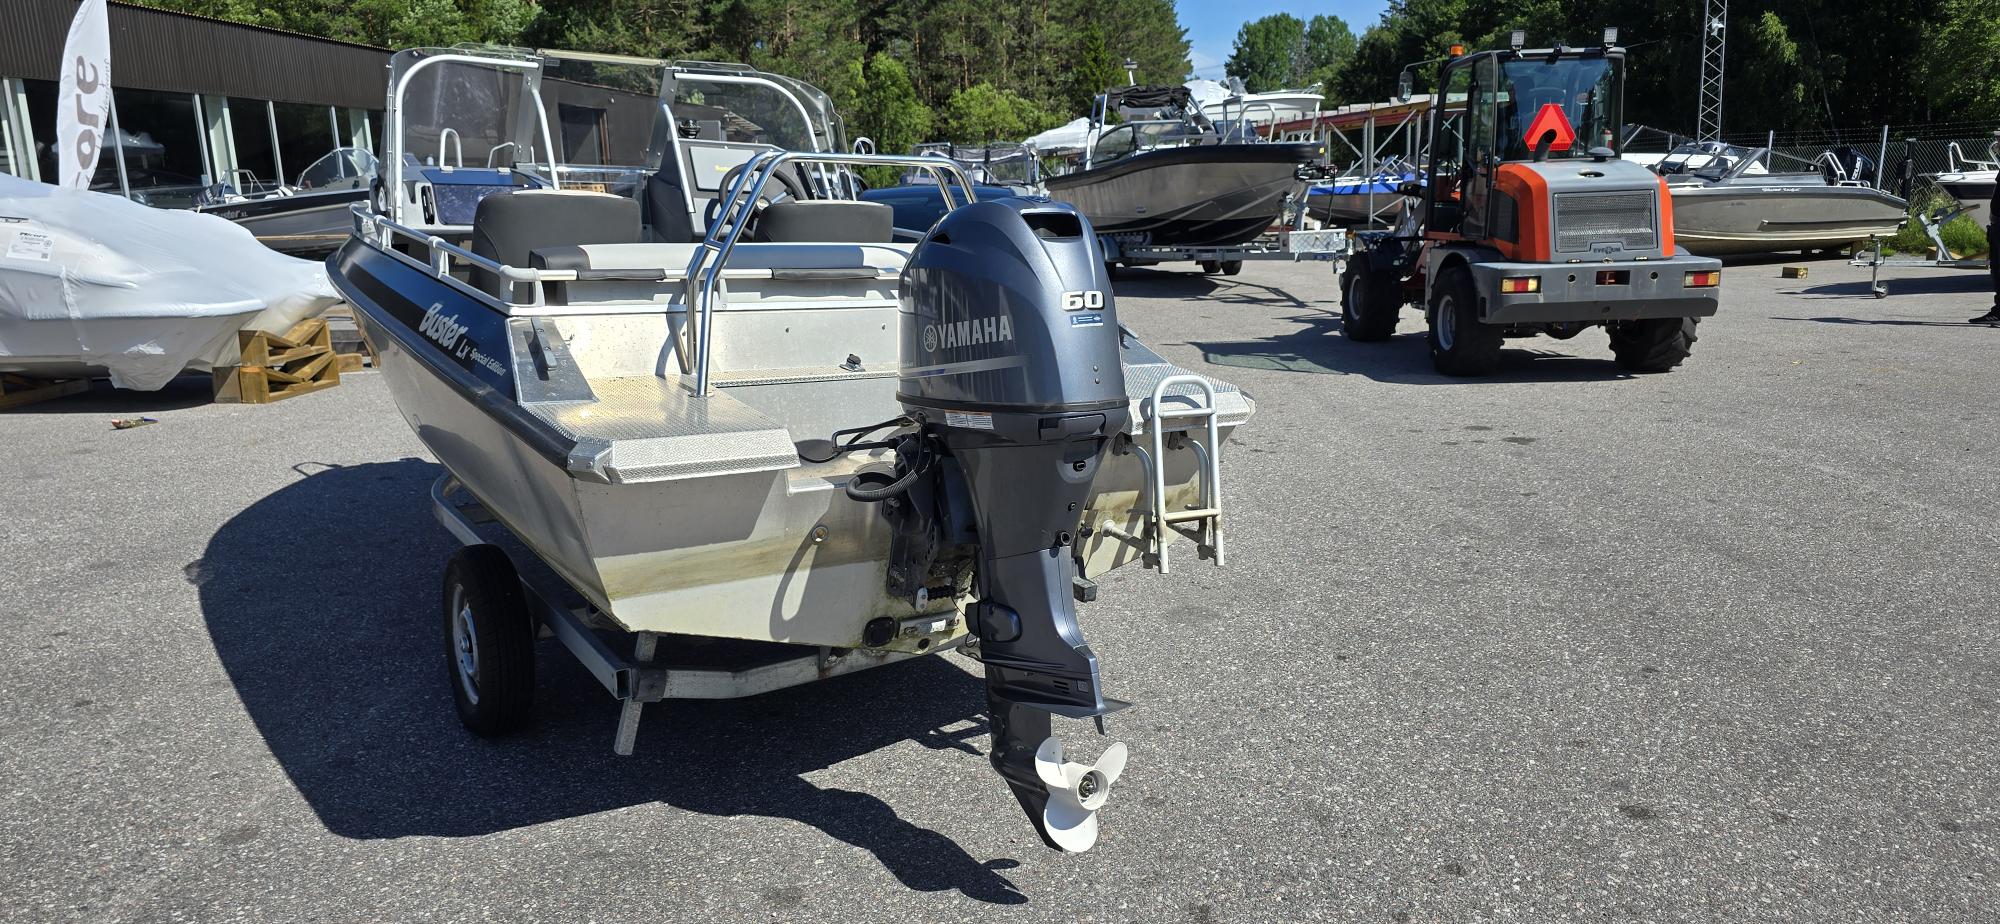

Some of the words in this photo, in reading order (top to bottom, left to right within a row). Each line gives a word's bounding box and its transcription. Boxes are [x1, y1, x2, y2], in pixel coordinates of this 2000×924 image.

[1061, 290, 1104, 311] 60
[419, 302, 469, 350] Buster
[470, 348, 490, 367] Special
[486, 359, 507, 377] Edition
[937, 315, 1013, 349] YAMAHA
